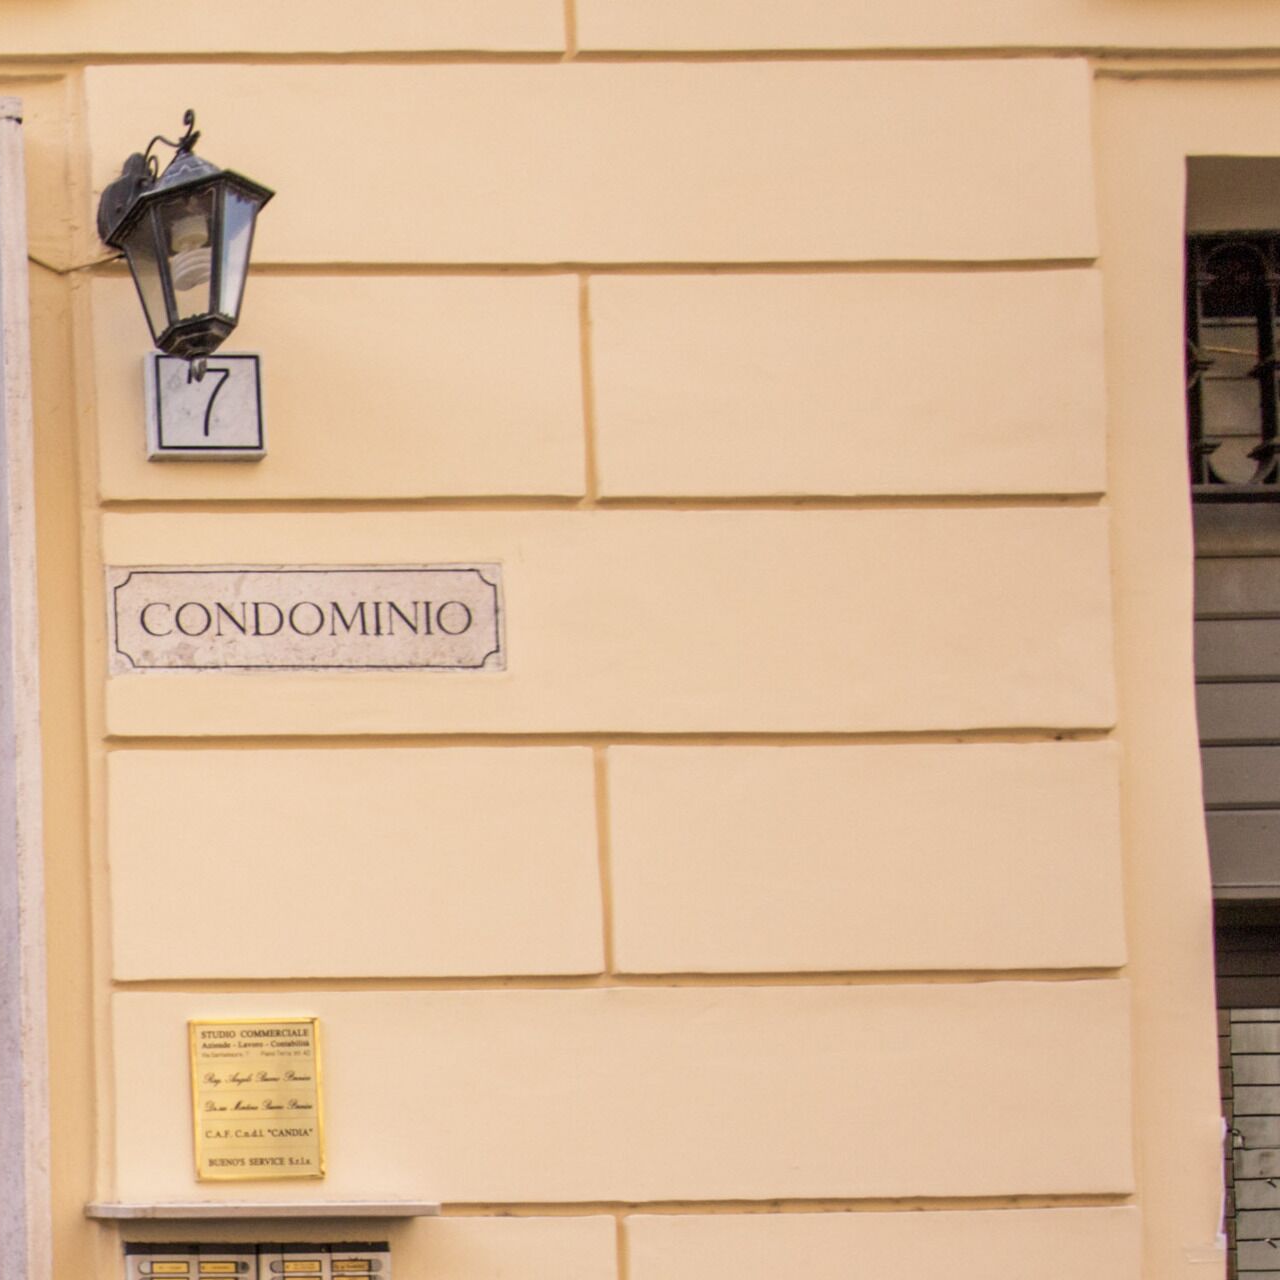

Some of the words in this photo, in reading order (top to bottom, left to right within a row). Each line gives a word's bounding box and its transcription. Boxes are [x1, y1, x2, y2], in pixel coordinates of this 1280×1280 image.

[187, 367, 230, 437] 7
[139, 600, 474, 637] CONDOMINIO
[200, 1030, 236, 1039] STUDIO
[240, 1028, 309, 1038] COMMERCIALE
[249, 1157, 285, 1166] SERVICE
